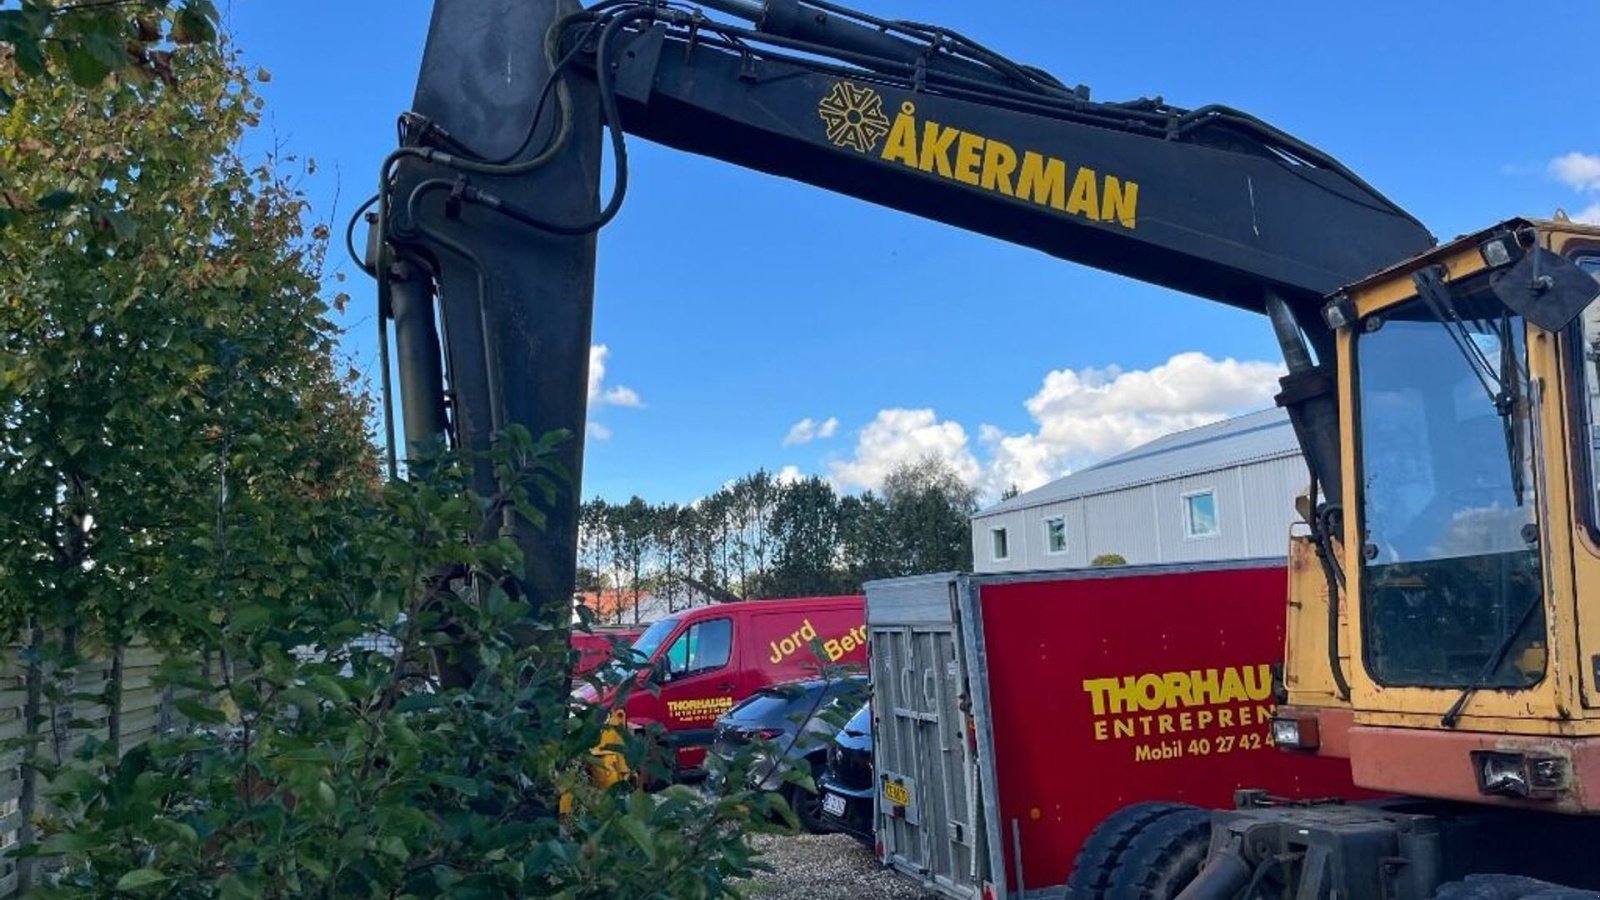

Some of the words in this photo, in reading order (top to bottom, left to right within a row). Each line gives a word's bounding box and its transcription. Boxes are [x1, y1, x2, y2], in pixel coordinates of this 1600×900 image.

[880, 101, 1139, 229] ÅKERMAN
[769, 618, 817, 664] Jord
[1082, 664, 1273, 716] THORHAU
[1094, 704, 1275, 741] ENTREPREN
[1135, 739, 1183, 762] Mobil
[1187, 738, 1211, 756] 40
[1215, 735, 1236, 753] 27
[1239, 732, 1261, 750] 42
